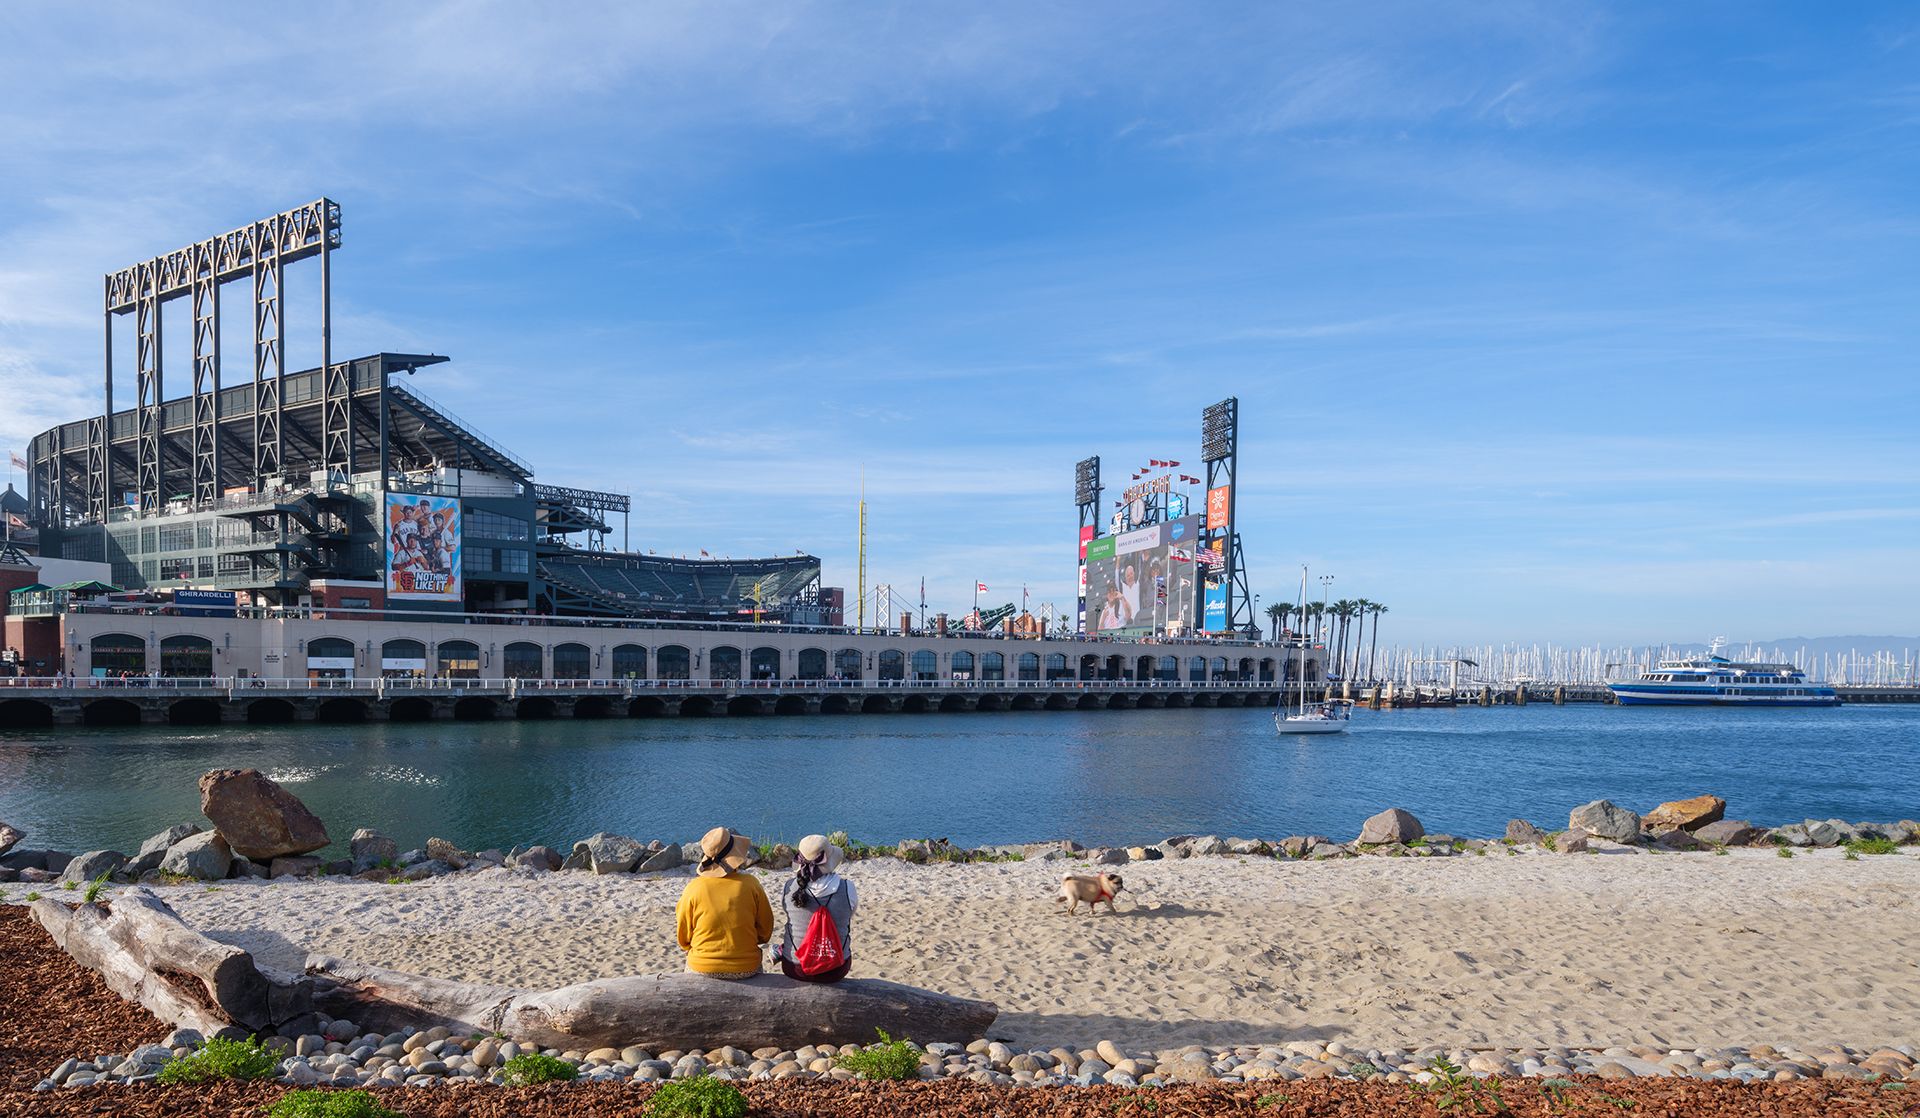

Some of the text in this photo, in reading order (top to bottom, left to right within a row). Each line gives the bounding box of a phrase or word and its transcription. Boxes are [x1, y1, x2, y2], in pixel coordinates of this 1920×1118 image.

[416, 573, 448, 582] NOTHING
[415, 580, 446, 591] LIKE IT
[179, 590, 232, 599] GHIRARDELLI
[1206, 600, 1225, 610] Alaska
